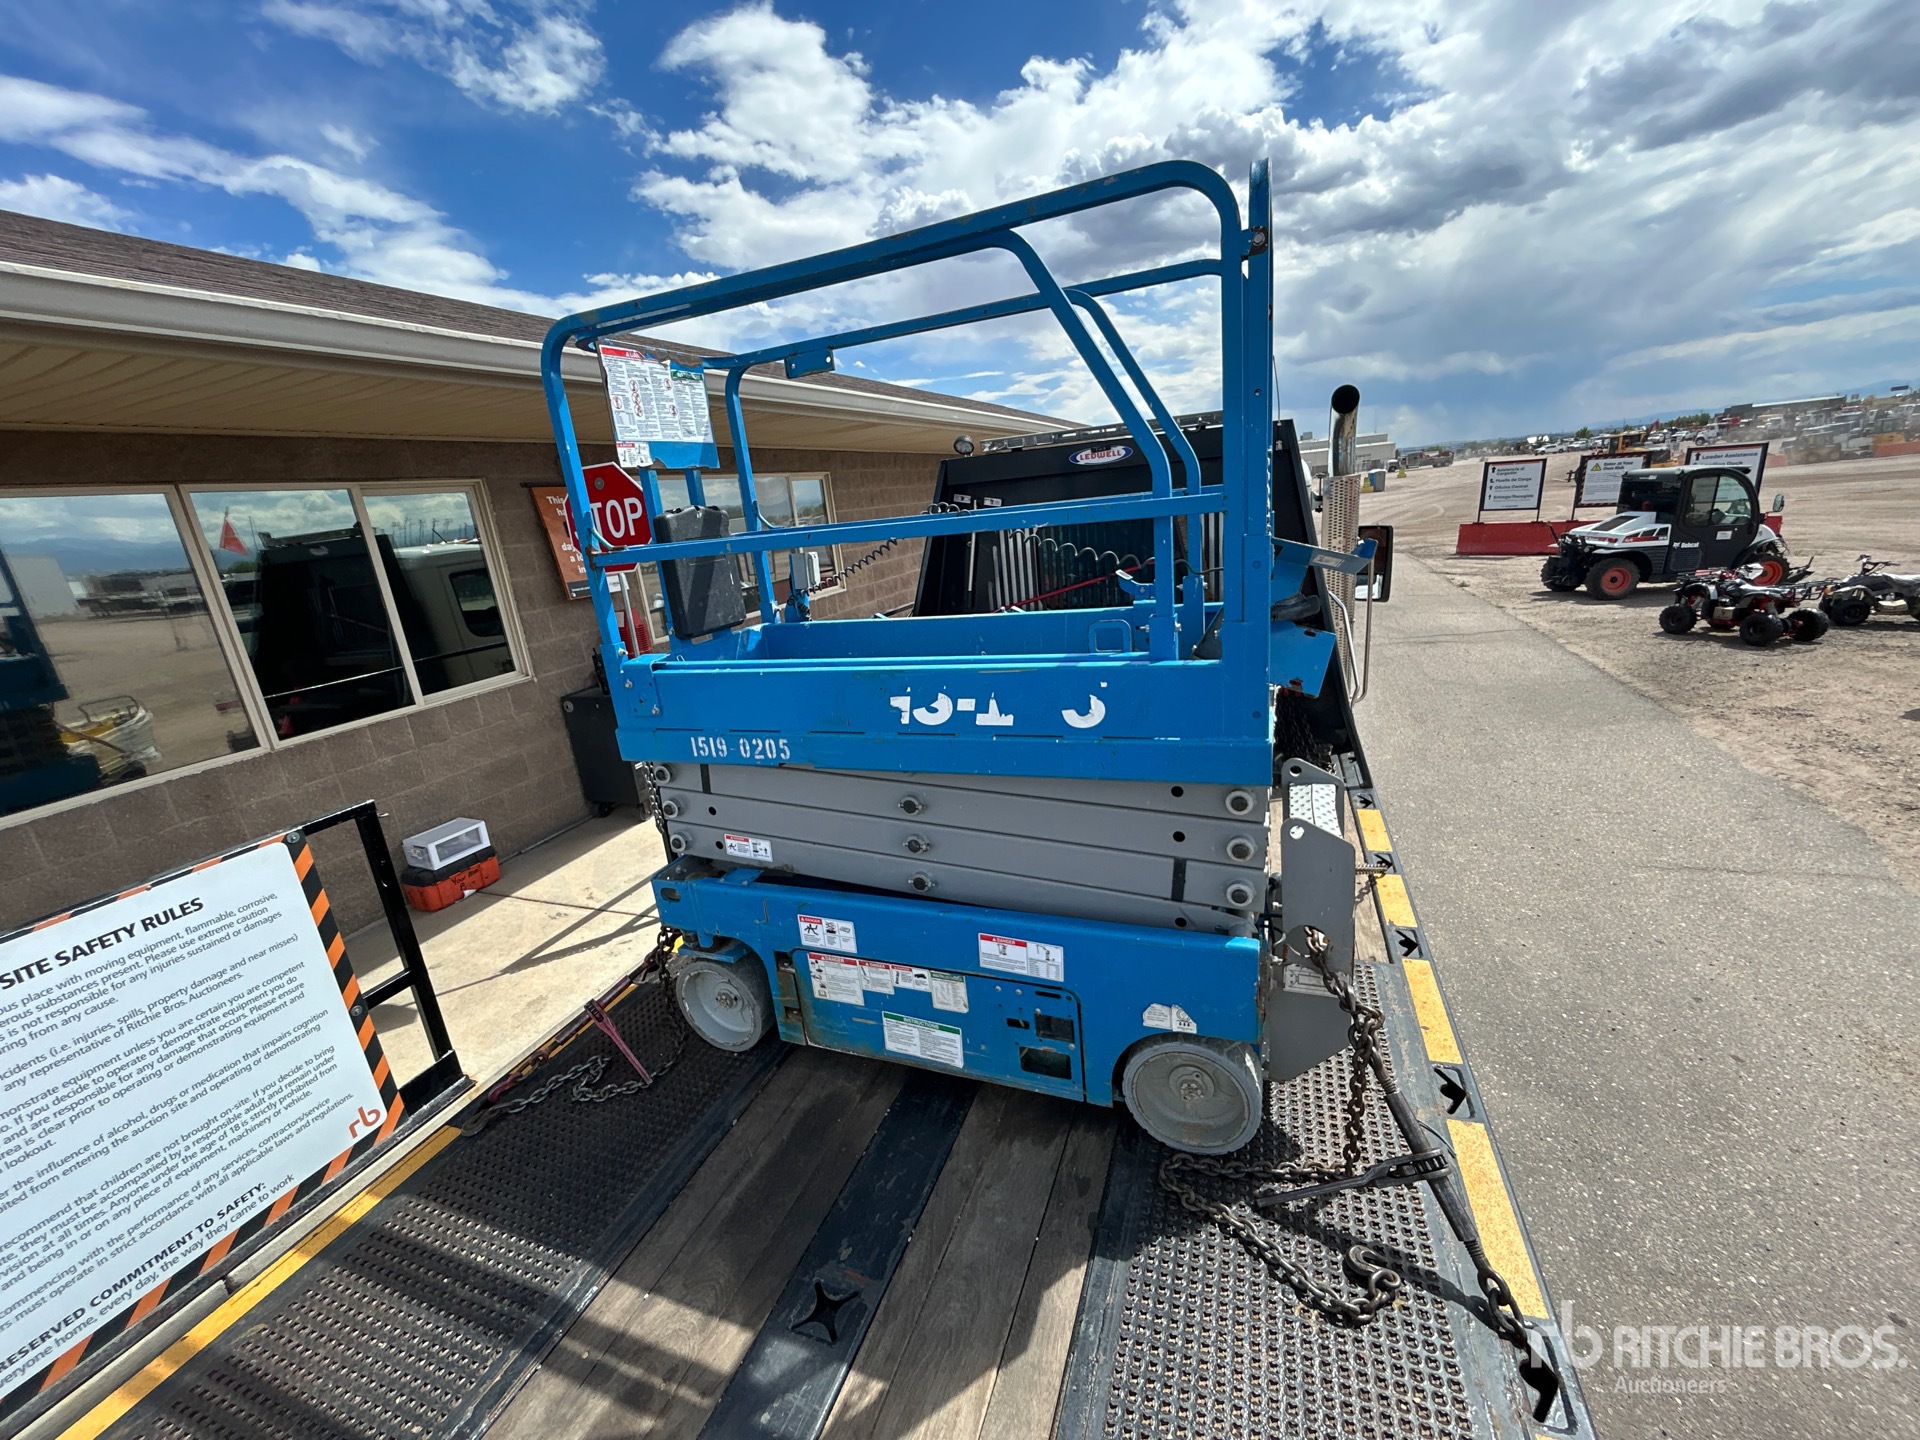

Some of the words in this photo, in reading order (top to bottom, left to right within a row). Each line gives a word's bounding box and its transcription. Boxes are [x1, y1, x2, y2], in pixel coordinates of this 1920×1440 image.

[1080, 449, 1122, 461] LEDWELL
[575, 497, 643, 540] TOP
[1680, 540, 1700, 549] Bobcat
[0, 957, 53, 990] SITE
[54, 922, 135, 967] SAFETY
[140, 897, 204, 932] RULES
[6, 1027, 19, 1037] is
[20, 1016, 44, 1031] not
[44, 987, 110, 1021] responsible
[110, 979, 126, 991] for
[128, 970, 147, 984] any
[148, 953, 186, 974] injuries
[186, 931, 231, 958] sustained
[231, 928, 242, 937] or
[243, 911, 282, 932] damages
[20, 987, 54, 1007] place
[54, 973, 83, 990] with
[84, 956, 127, 979] moving
[126, 932, 184, 960] equipment,
[184, 910, 237, 935] flammable,
[237, 893, 278, 913] corrosive,
[34, 979, 100, 1012] substances
[100, 961, 144, 986] present.
[144, 946, 177, 965] Please
[178, 938, 196, 950] use
[197, 921, 235, 941] extreme
[235, 906, 269, 925] caution
[49, 1043, 72, 1057] (i.e.
[71, 1022, 116, 1046] injuries,
[116, 1007, 146, 1025] spills,
[146, 986, 188, 1012] property
[189, 968, 228, 990] damage
[229, 957, 247, 971] and
[247, 948, 267, 963] near
[268, 933, 298, 953] misses)
[2, 1125, 29, 1145] and
[30, 1116, 51, 1131] are
[52, 1081, 117, 1119] responsible
[117, 1071, 133, 1084] for
[135, 1060, 154, 1075] any
[156, 1039, 196, 1064] damage
[196, 1027, 217, 1042] that
[217, 1012, 249, 1031] occurs.
[248, 997, 277, 1015] Please
[277, 982, 305, 1000] ensure
[3, 1075, 26, 1092] any
[28, 1035, 111, 1079] representative
[112, 1025, 125, 1038] of
[125, 1011, 162, 1032] Ritchie
[162, 999, 188, 1014] Bros.
[188, 972, 244, 1002] Auctioneers.
[13, 1113, 24, 1126] If
[25, 1103, 50, 1122] you
[51, 1083, 91, 1106] decide
[90, 1075, 105, 1086] to
[105, 1053, 147, 1078] operate
[148, 1046, 159, 1056] or
[161, 1015, 221, 1050] demonstrate
[221, 990, 269, 1018] equipment
[268, 982, 286, 996] you
[285, 976, 297, 985] do
[23, 1136, 36, 1147] is
[37, 1119, 66, 1139] clear
[68, 1103, 95, 1124] prior
[97, 1096, 111, 1107] to
[112, 1068, 163, 1099] operating
[163, 1061, 174, 1072] or
[175, 1025, 243, 1065] demonstrating
[243, 1000, 288, 1029] equipment
[289, 990, 305, 1004] and
[28, 1023, 59, 1040] from
[60, 1012, 81, 1026] any
[83, 997, 119, 1016] cause.
[61, 1053, 122, 1089] equipment
[122, 1036, 156, 1058] unless
[156, 1026, 177, 1042] you
[177, 1018, 194, 1030] are
[195, 1001, 227, 1021] certain
[227, 992, 245, 1006] you
[246, 984, 261, 996] are
[261, 961, 305, 987] competent
[3, 1139, 57, 1170] lookout.
[11, 1176, 35, 1191] the
[35, 1144, 91, 1178] influence
[92, 1133, 105, 1146] of
[106, 1111, 149, 1139] alcohol,
[149, 1094, 178, 1114] drugs
[178, 1087, 189, 1098] or
[191, 1058, 242, 1091] medication
[241, 1047, 261, 1061] that
[261, 1029, 292, 1051] impairs
[292, 1009, 329, 1033] cognition
[73, 1188, 99, 1207] that
[99, 1162, 143, 1191] children
[144, 1151, 162, 1165] are
[162, 1139, 181, 1153] not
[180, 1115, 219, 1142] brought
[219, 1097, 252, 1119] on-site.
[252, 1088, 260, 1098] If
[259, 1080, 277, 1096] you
[277, 1064, 304, 1083] decide
[304, 1058, 314, 1066] to
[313, 1045, 335, 1061] bring
[53, 1316, 98, 1347] home,
[98, 1288, 132, 1316] every
[134, 1271, 159, 1291] day,
[159, 1256, 180, 1272] the
[180, 1237, 204, 1257] way
[204, 1220, 228, 1240] they
[229, 1201, 257, 1223] came
[257, 1192, 269, 1203] to
[269, 1174, 295, 1194] work
[89, 1230, 193, 1307] COMMITMENT
[194, 1217, 214, 1233] TO
[216, 1182, 266, 1220] SAFETY:
